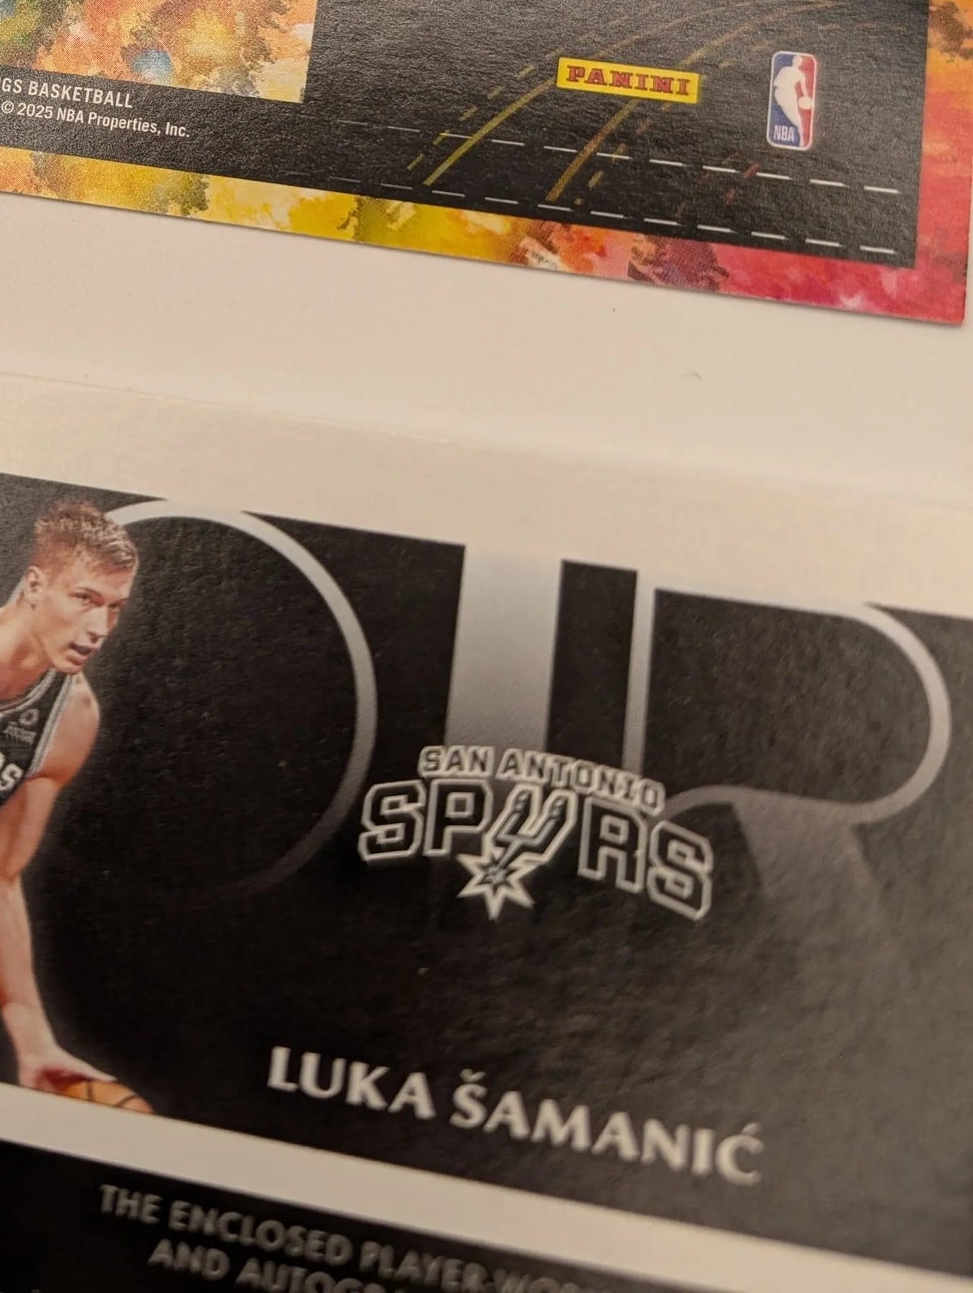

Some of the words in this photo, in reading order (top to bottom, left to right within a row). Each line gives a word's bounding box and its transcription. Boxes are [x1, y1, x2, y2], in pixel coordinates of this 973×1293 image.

[28, 80, 134, 109] BASKETBALL
[566, 65, 690, 96] PANINI
[16, 101, 54, 120] 2025
[56, 106, 85, 124] NBA
[87, 109, 162, 135] Properties,
[165, 120, 190, 138] Inc.
[773, 125, 795, 142] NBA
[418, 745, 495, 778] SAN
[496, 748, 665, 816] ANTONIO
[358, 778, 714, 920] SPURS
[267, 1045, 436, 1120] LUKA
[448, 1068, 764, 1187] ŠAMANIĆ
[100, 1184, 163, 1225] THE
[168, 1199, 353, 1266] ENCLOSED
[147, 1237, 230, 1282] AND
